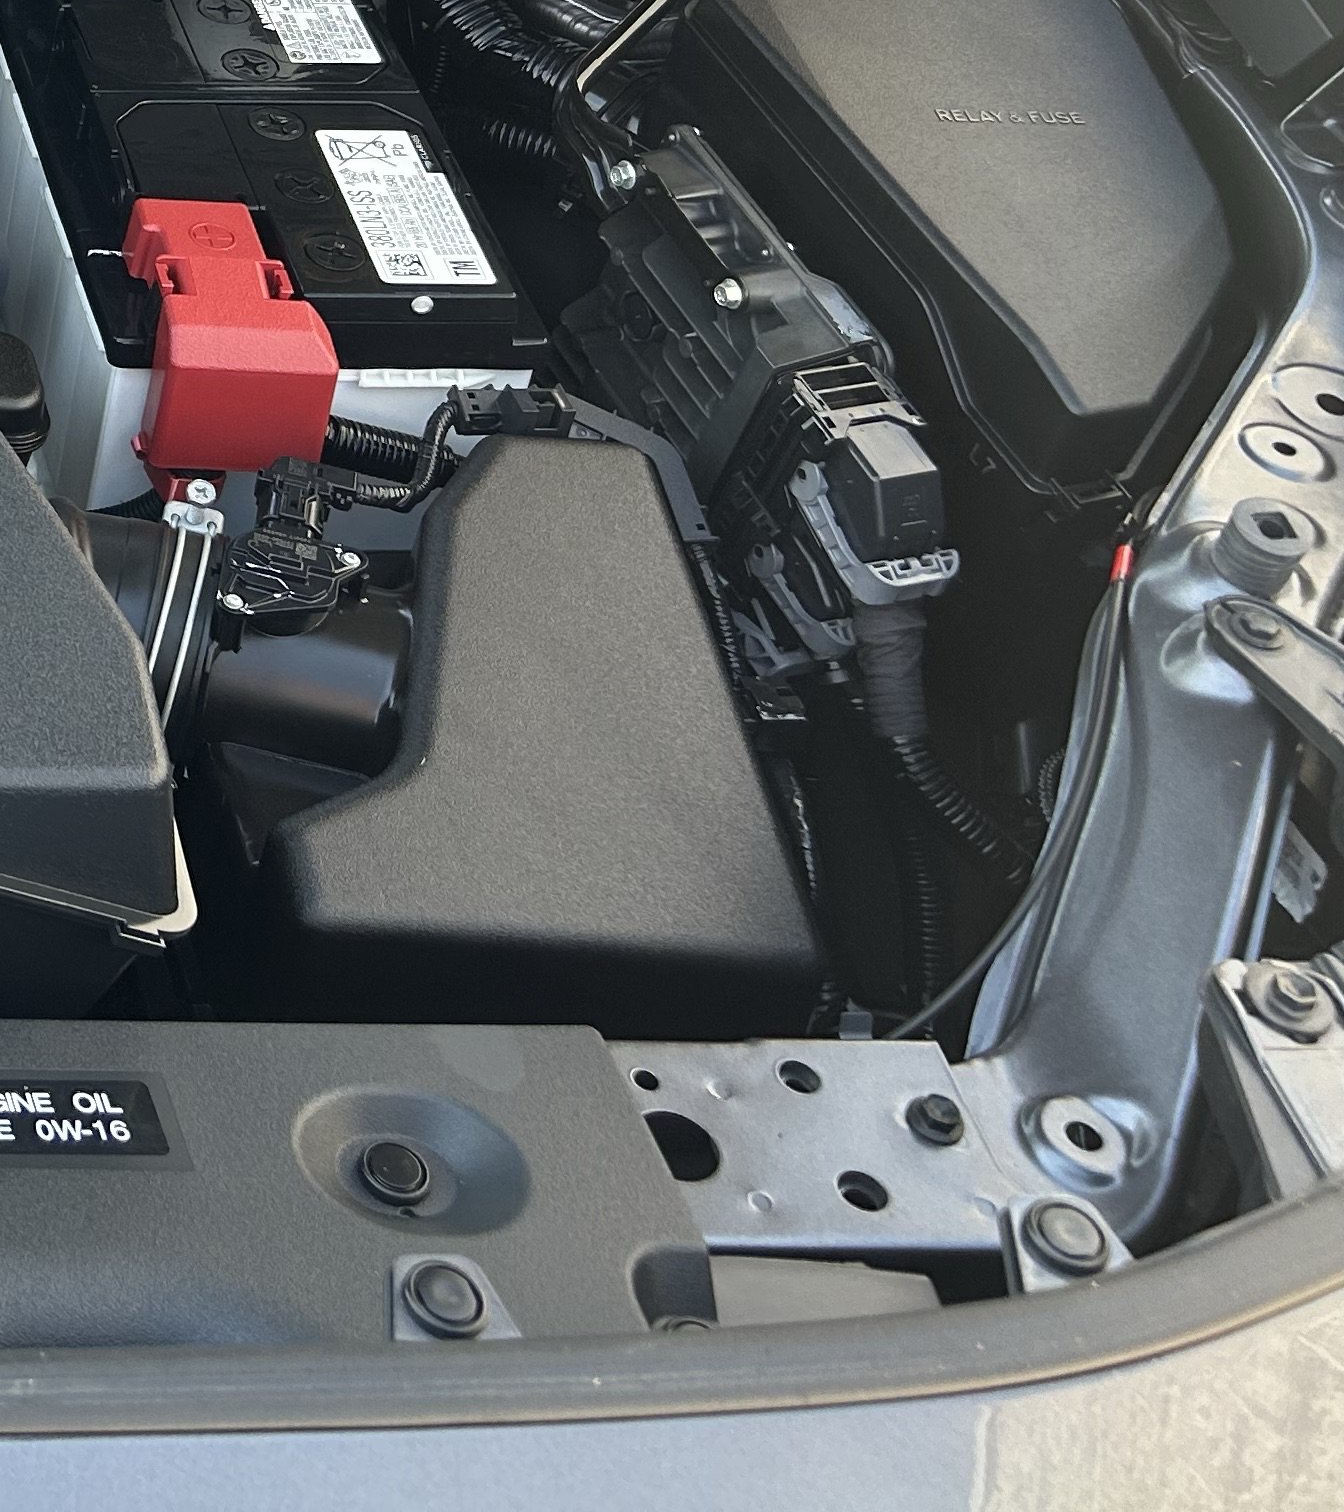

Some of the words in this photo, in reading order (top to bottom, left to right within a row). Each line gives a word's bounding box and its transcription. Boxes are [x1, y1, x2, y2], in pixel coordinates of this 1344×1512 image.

[934, 108, 1004, 123] RELAY
[1008, 110, 1025, 124] &
[1026, 110, 1087, 125] FUSE
[391, 143, 408, 156] Pb
[449, 260, 482, 277] TM
[72, 1091, 124, 1115] OIL
[34, 1119, 132, 1143] 0W-16
